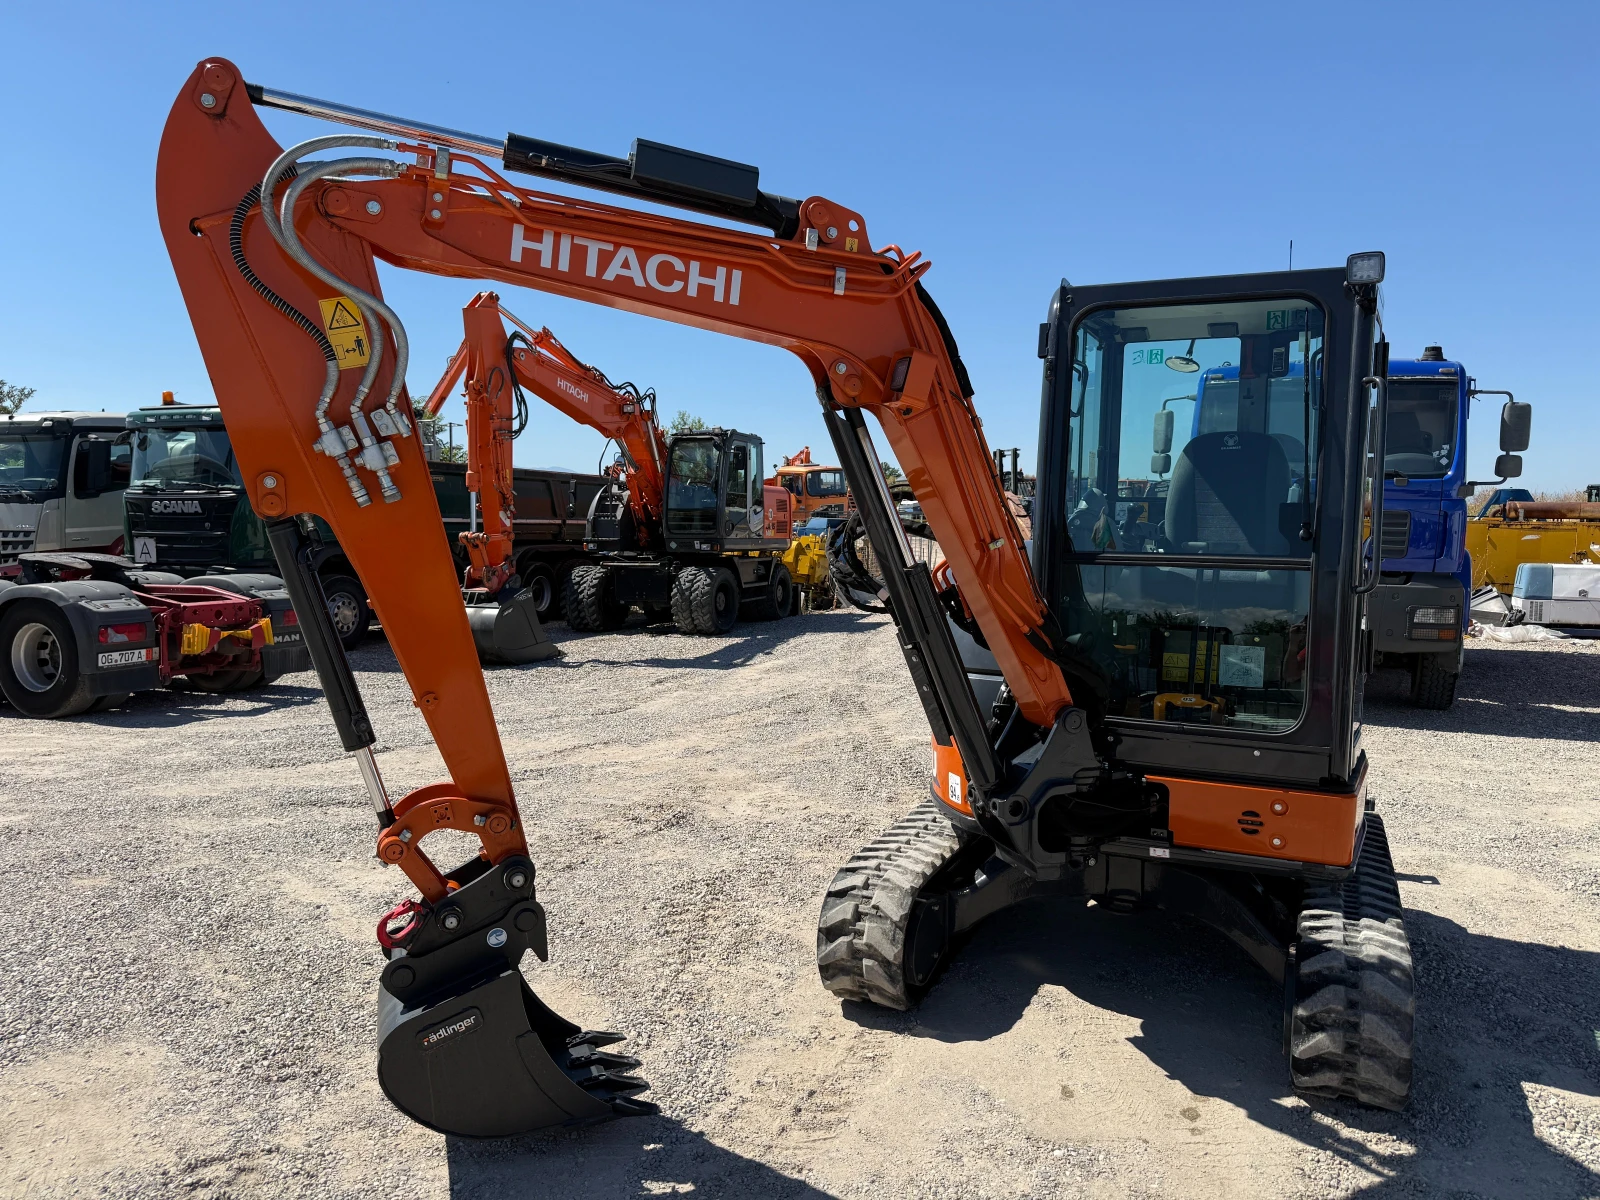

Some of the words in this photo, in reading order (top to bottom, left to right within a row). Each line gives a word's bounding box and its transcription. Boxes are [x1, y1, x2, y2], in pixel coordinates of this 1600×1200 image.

[510, 223, 743, 306] HITACHI
[557, 376, 589, 403] HITACHI
[151, 500, 203, 513] SCANIA
[139, 541, 152, 559] A
[274, 633, 300, 643] MAN
[101, 654, 113, 665] OG
[118, 651, 136, 663] 707
[137, 650, 143, 661] A
